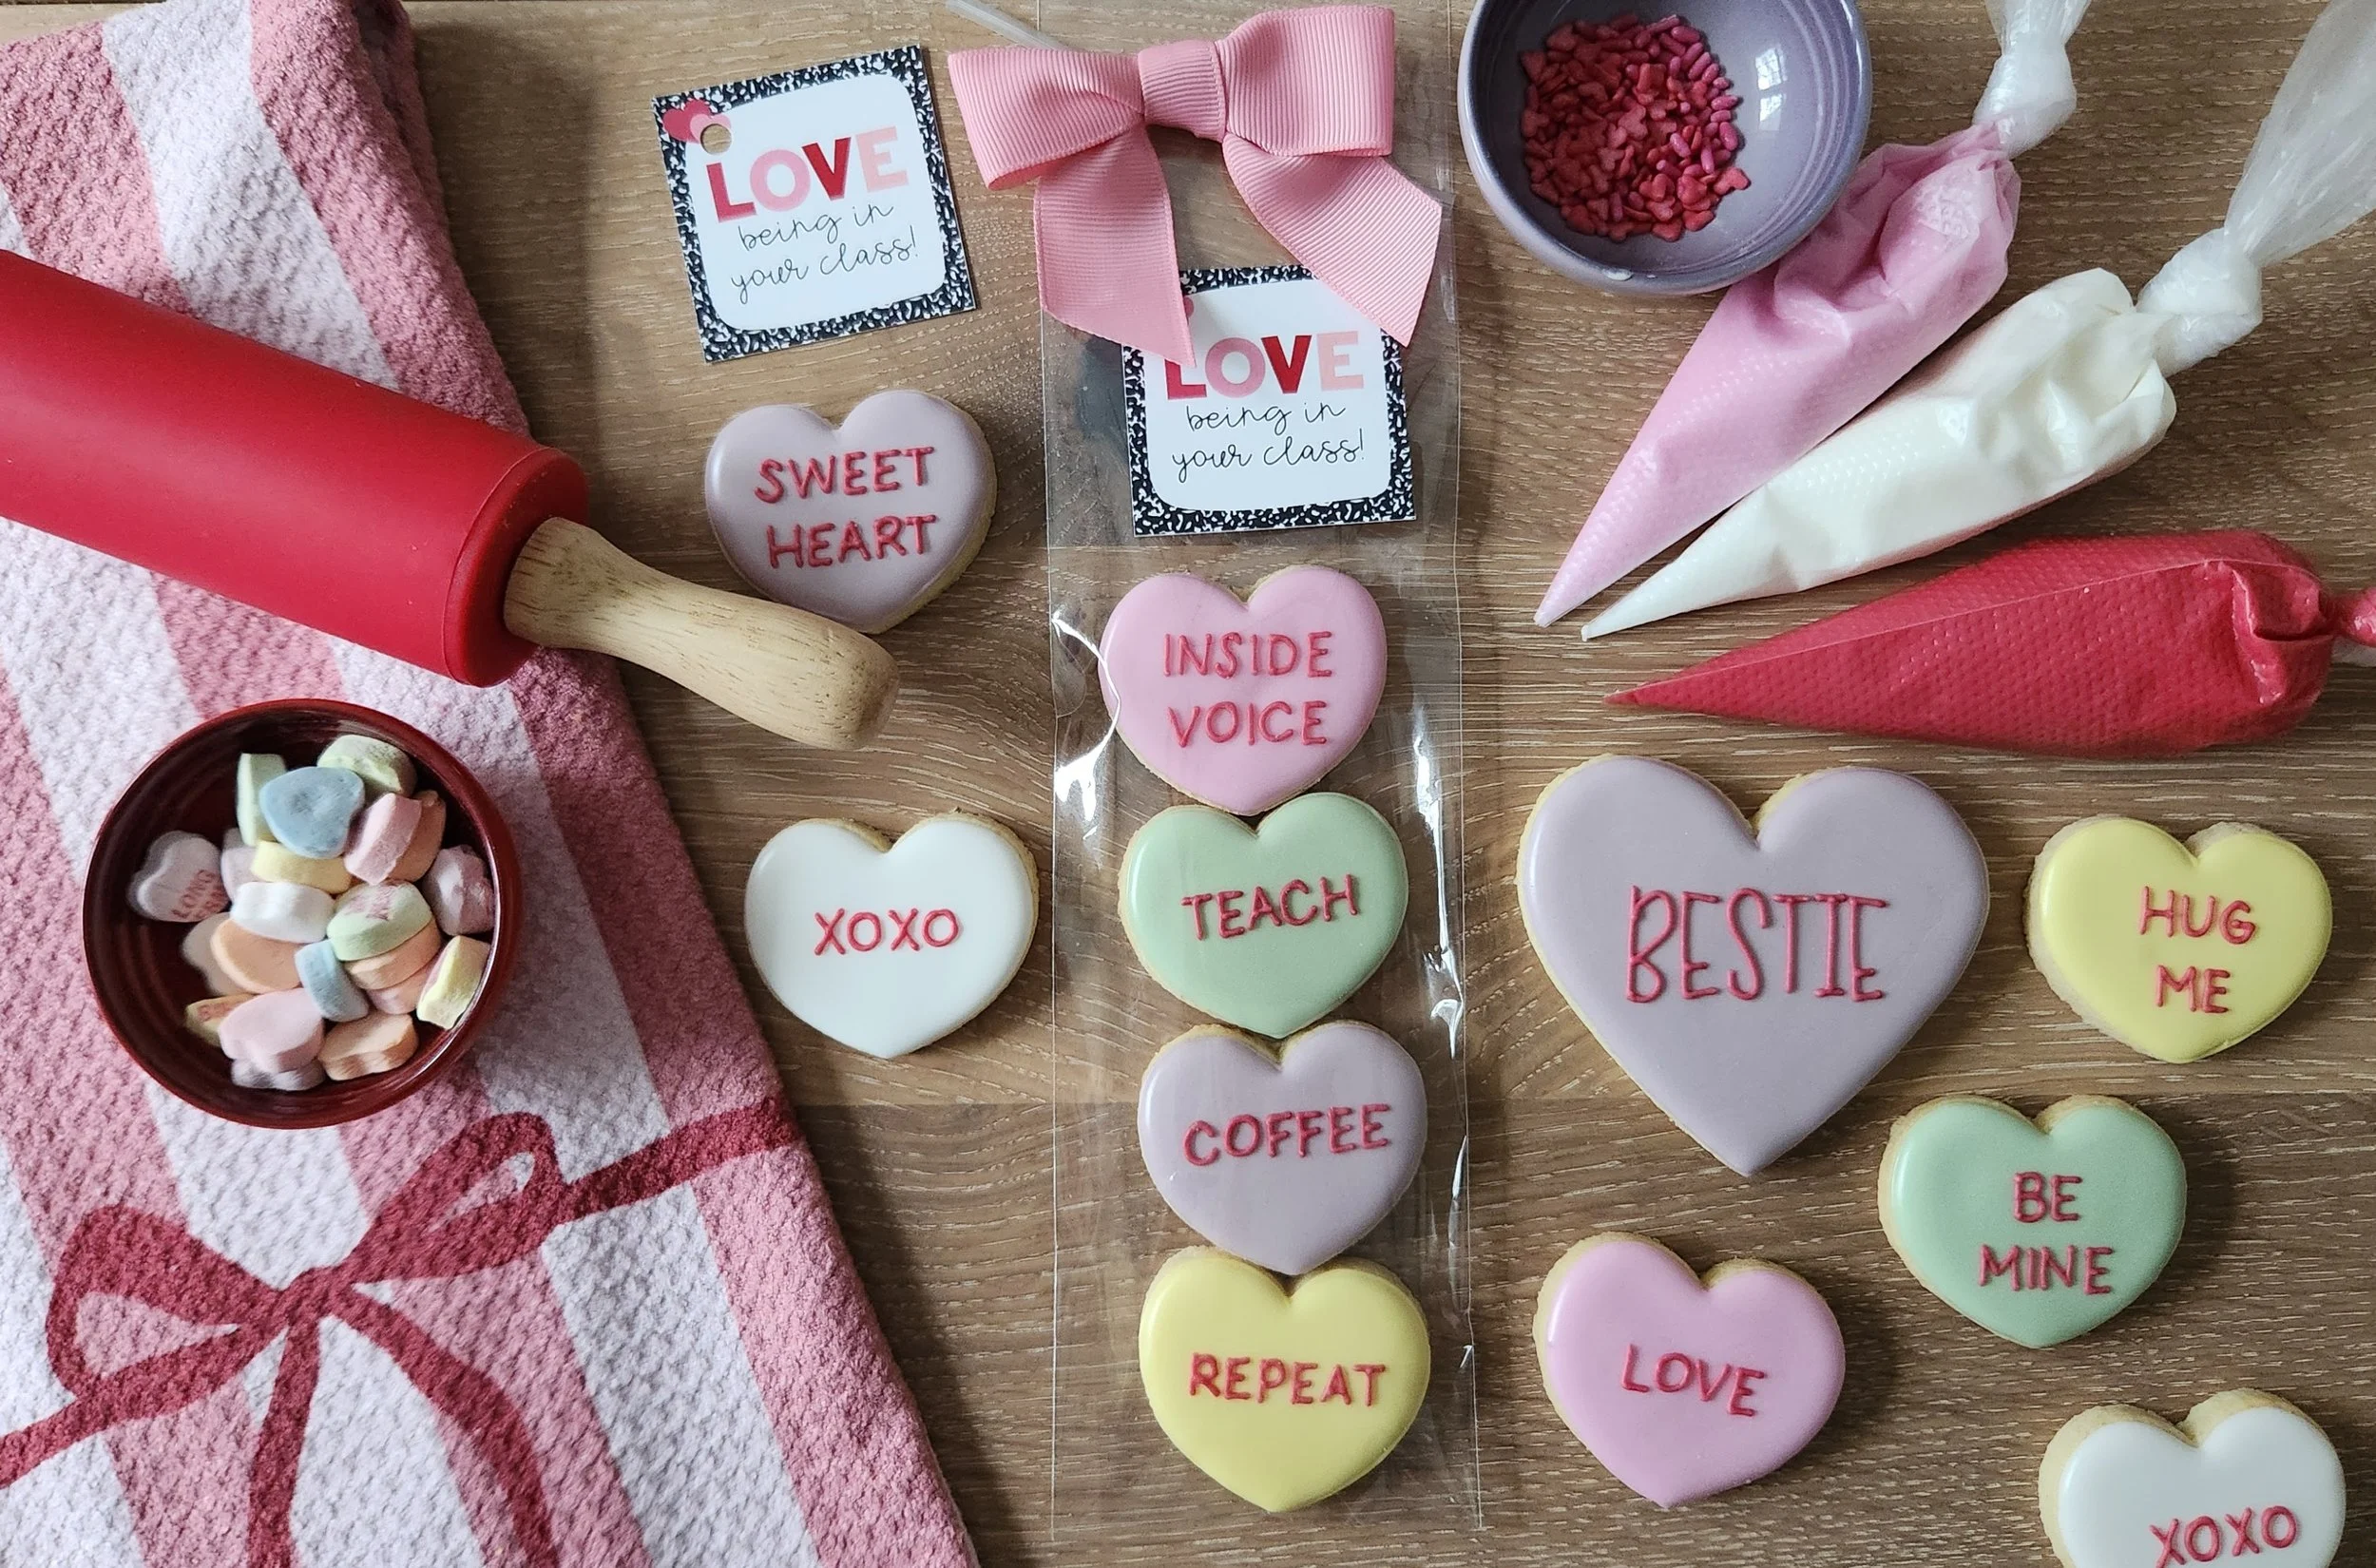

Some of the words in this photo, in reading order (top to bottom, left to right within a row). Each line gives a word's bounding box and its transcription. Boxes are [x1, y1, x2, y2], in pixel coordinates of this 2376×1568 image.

[705, 125, 910, 223] LOVE
[738, 211, 841, 253] being
[853, 203, 894, 229] in
[729, 258, 810, 306] your
[818, 225, 918, 277] class!
[1164, 329, 1365, 401] LOVE
[1185, 403, 1293, 435] being
[1303, 400, 1347, 425] in
[754, 446, 933, 503] SWEET
[1171, 442, 1254, 485] your
[1262, 427, 1366, 467] class!
[767, 513, 936, 567] HEART
[1164, 630, 1332, 679] INSIDE
[1167, 698, 1328, 749] VOICE
[814, 907, 960, 955] XOXO
[1181, 873, 1359, 940] TEACH
[2139, 888, 2257, 943] HUG
[1625, 885, 1887, 1004] BESTIE
[2156, 964, 2230, 1013] ME
[1181, 1102, 1389, 1167] COFFEE
[2013, 1171, 2081, 1223] BE
[1979, 1245, 2111, 1295] MINE
[1189, 1352, 1386, 1405] REPEAT
[1620, 1345, 1766, 1418] LOVE
[2150, 1504, 2298, 1568] XOXO
